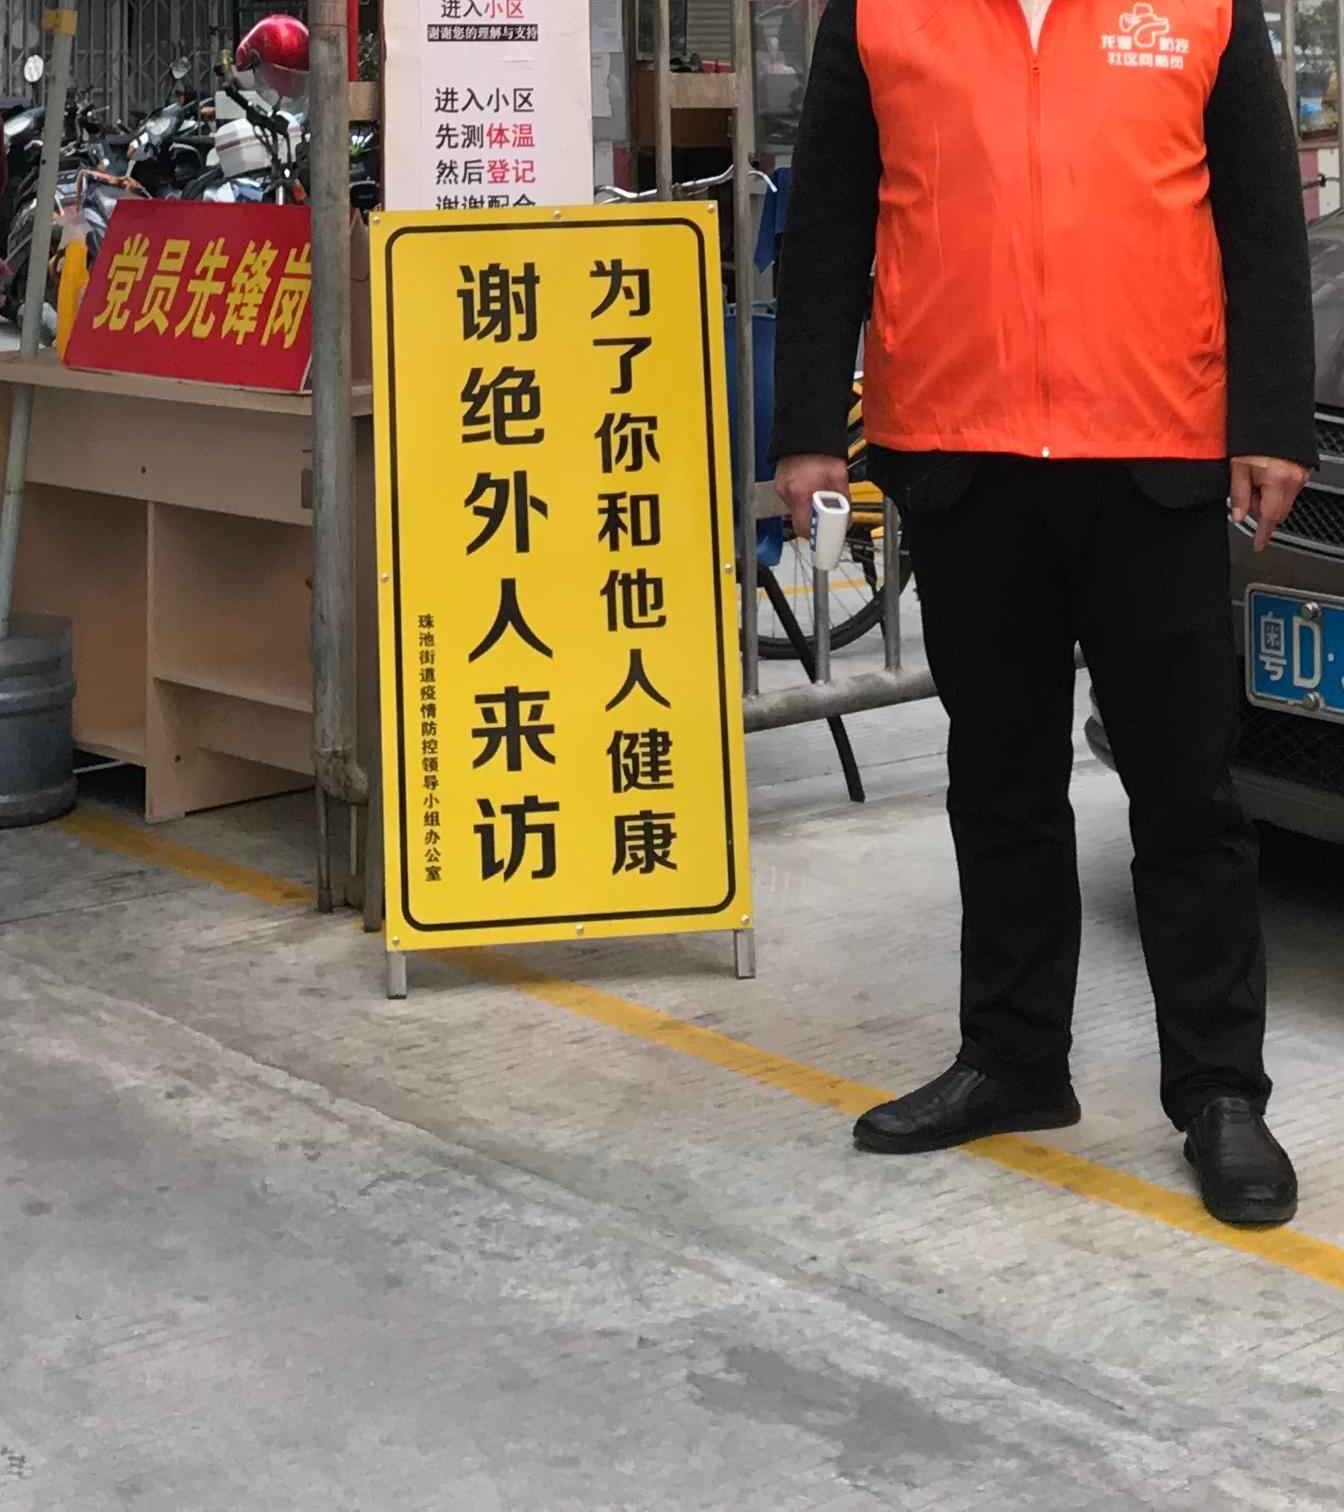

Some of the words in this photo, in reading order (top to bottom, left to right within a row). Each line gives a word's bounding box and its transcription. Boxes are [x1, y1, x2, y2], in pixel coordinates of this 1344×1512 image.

[428, 25, 538, 40] 谢谢您的理解与支持
[434, 88, 535, 113] 进入小区
[435, 123, 535, 149] 先测体温
[435, 159, 536, 185] 然后登记
[93, 233, 312, 349] 党员先锋岗
[457, 262, 560, 883] 谢绝外人来访
[590, 259, 678, 876] 为了你和他人健康
[417, 613, 442, 882] 珠池街道疫情防控领导小组办公室
